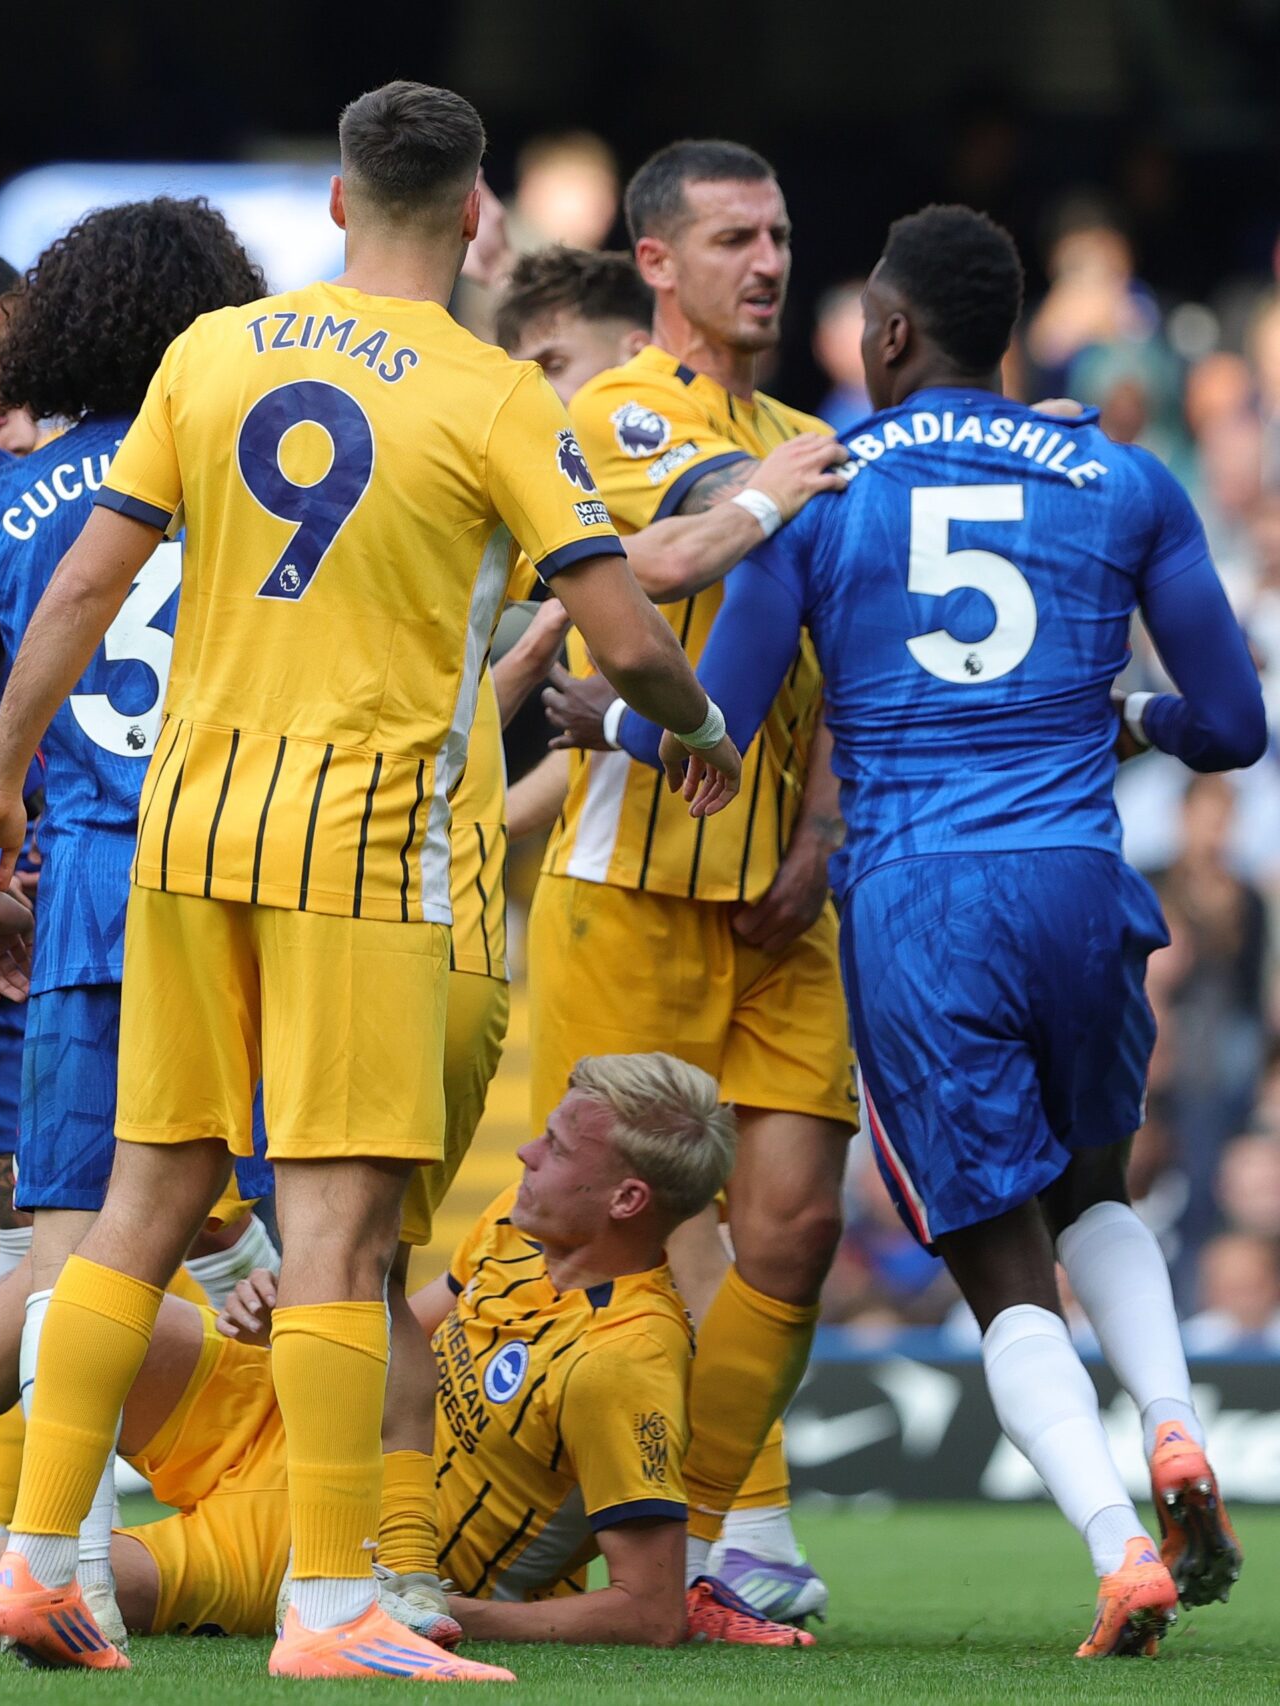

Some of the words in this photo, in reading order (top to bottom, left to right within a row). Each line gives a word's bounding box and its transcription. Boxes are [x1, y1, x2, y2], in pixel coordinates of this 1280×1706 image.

[246, 312, 419, 383] TZIMAS
[1, 440, 122, 541] CUCU
[236, 378, 375, 602] 9
[574, 502, 592, 516] No
[69, 541, 183, 758] 3
[905, 484, 1038, 684] 5
